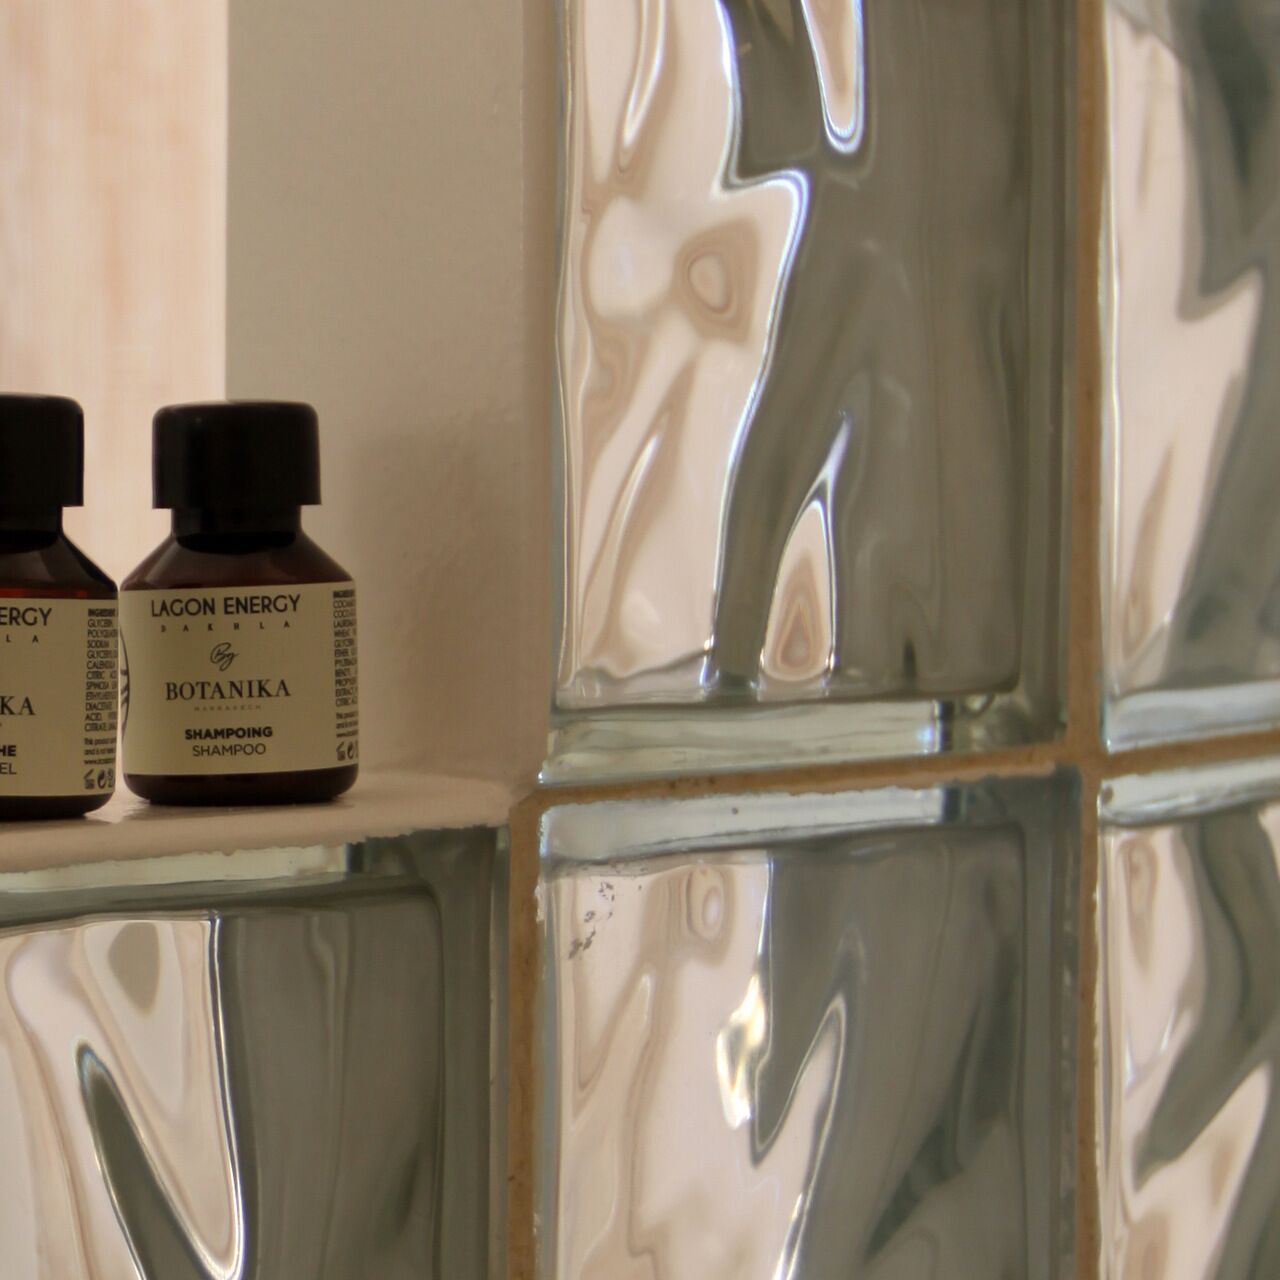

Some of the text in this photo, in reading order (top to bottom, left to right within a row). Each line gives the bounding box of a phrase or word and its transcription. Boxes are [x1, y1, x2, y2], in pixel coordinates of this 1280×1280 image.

[151, 594, 301, 617] LAGON ENERGY
[165, 679, 291, 702] BOTANIKA
[184, 726, 274, 740] SHAMPOING
[192, 742, 267, 757] SHAMPOO
